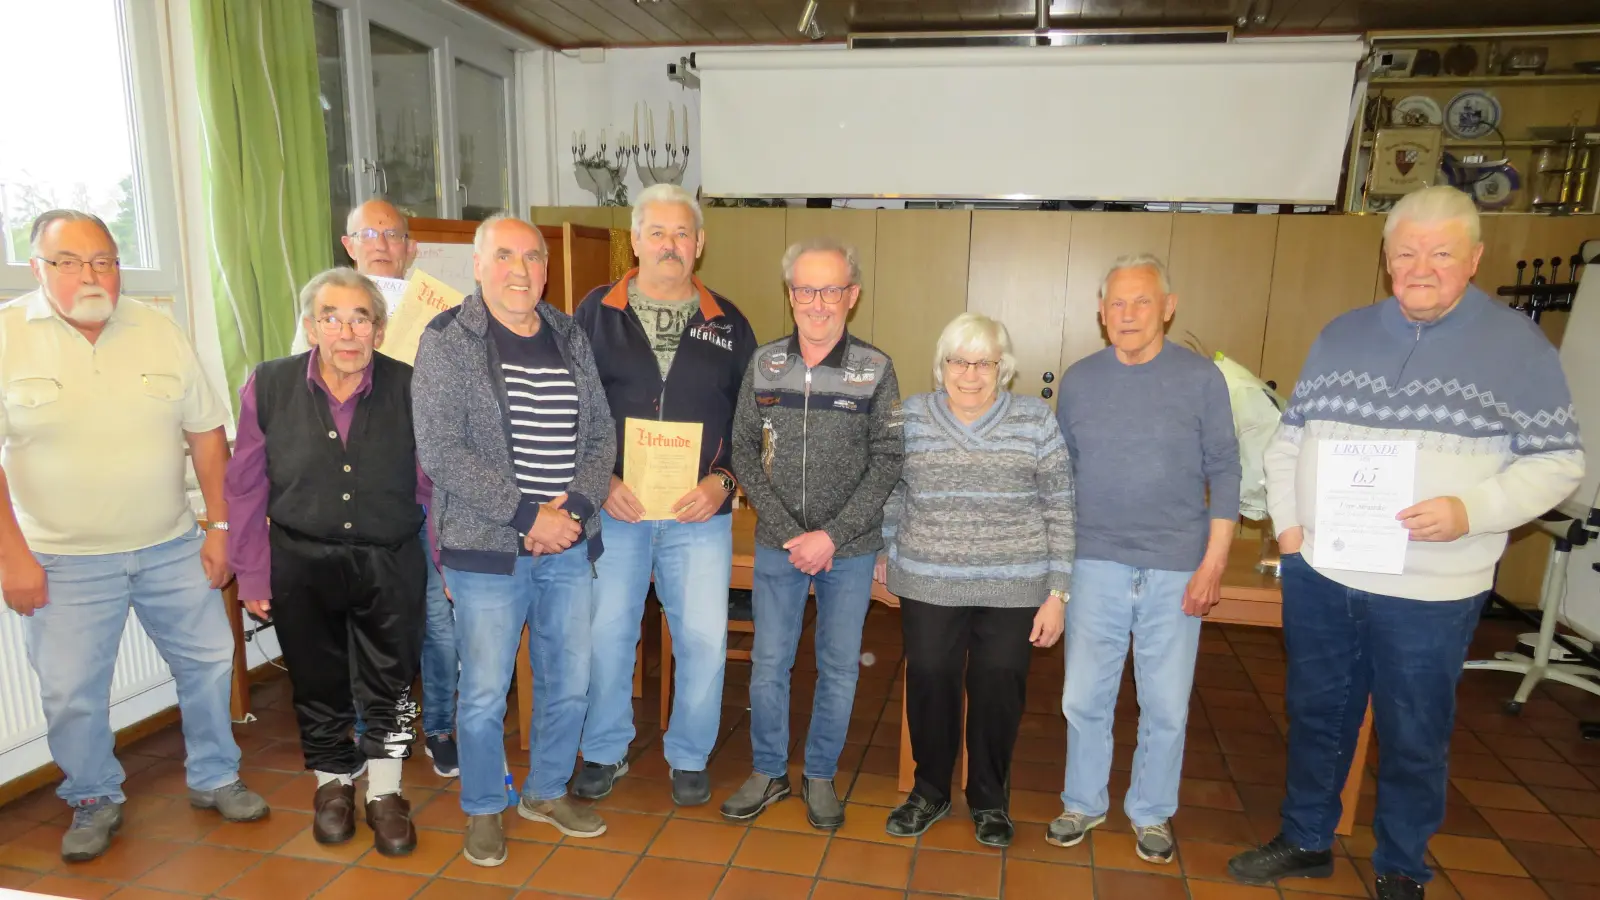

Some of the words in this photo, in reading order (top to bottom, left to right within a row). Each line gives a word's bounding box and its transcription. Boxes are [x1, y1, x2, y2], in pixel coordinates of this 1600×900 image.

[417, 281, 454, 312] Urku
[690, 327, 733, 352] HERITAGE
[636, 427, 692, 448] Urkunde
[1334, 444, 1400, 455] URKUNDE
